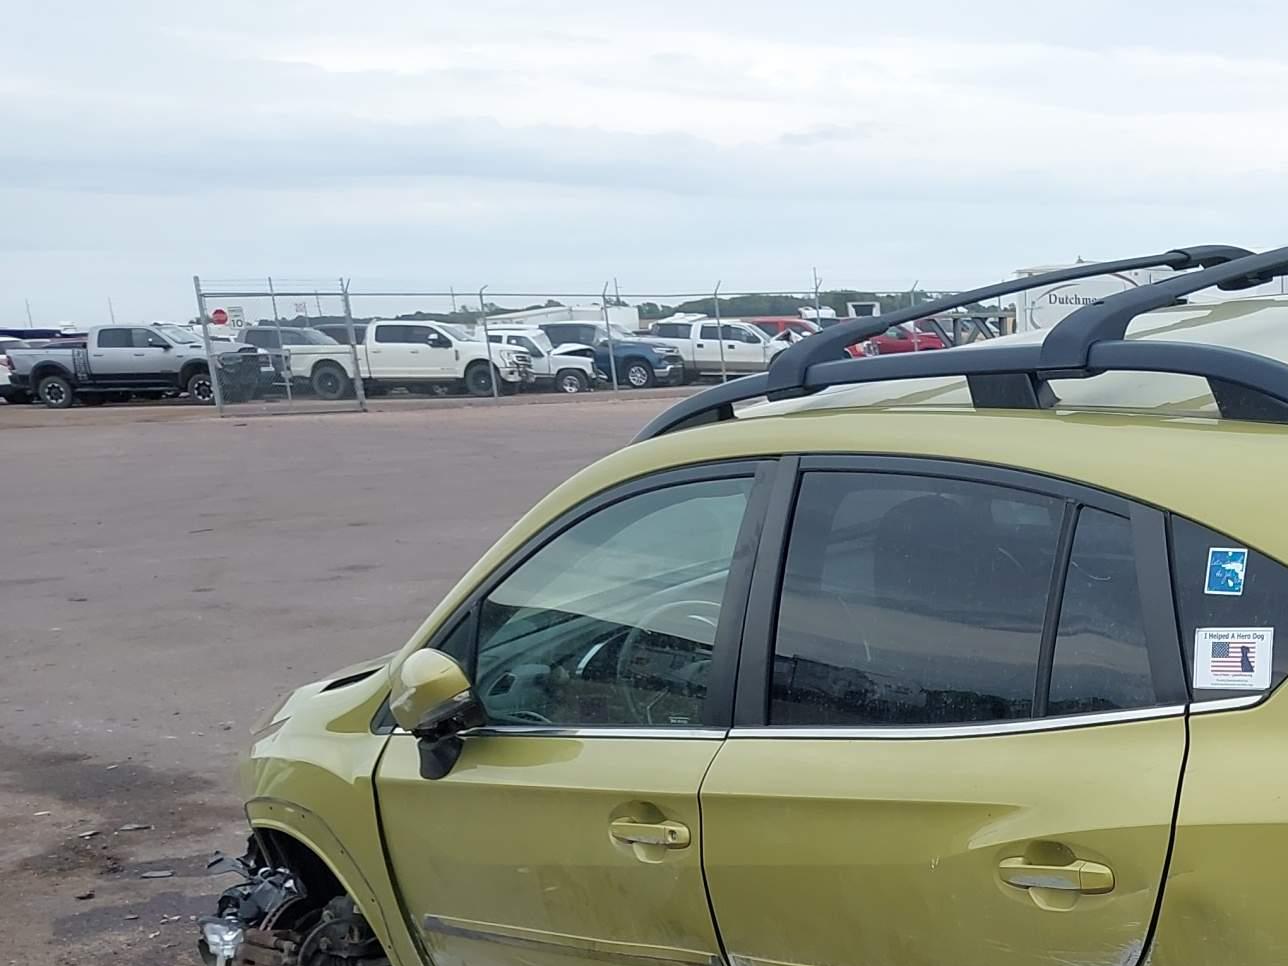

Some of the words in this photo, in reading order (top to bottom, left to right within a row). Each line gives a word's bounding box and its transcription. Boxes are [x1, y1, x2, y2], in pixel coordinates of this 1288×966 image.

[231, 319, 243, 327] 10
[1208, 632, 1230, 640] Helped
[1237, 632, 1251, 640] Hero
[1252, 633, 1265, 641] Dog
